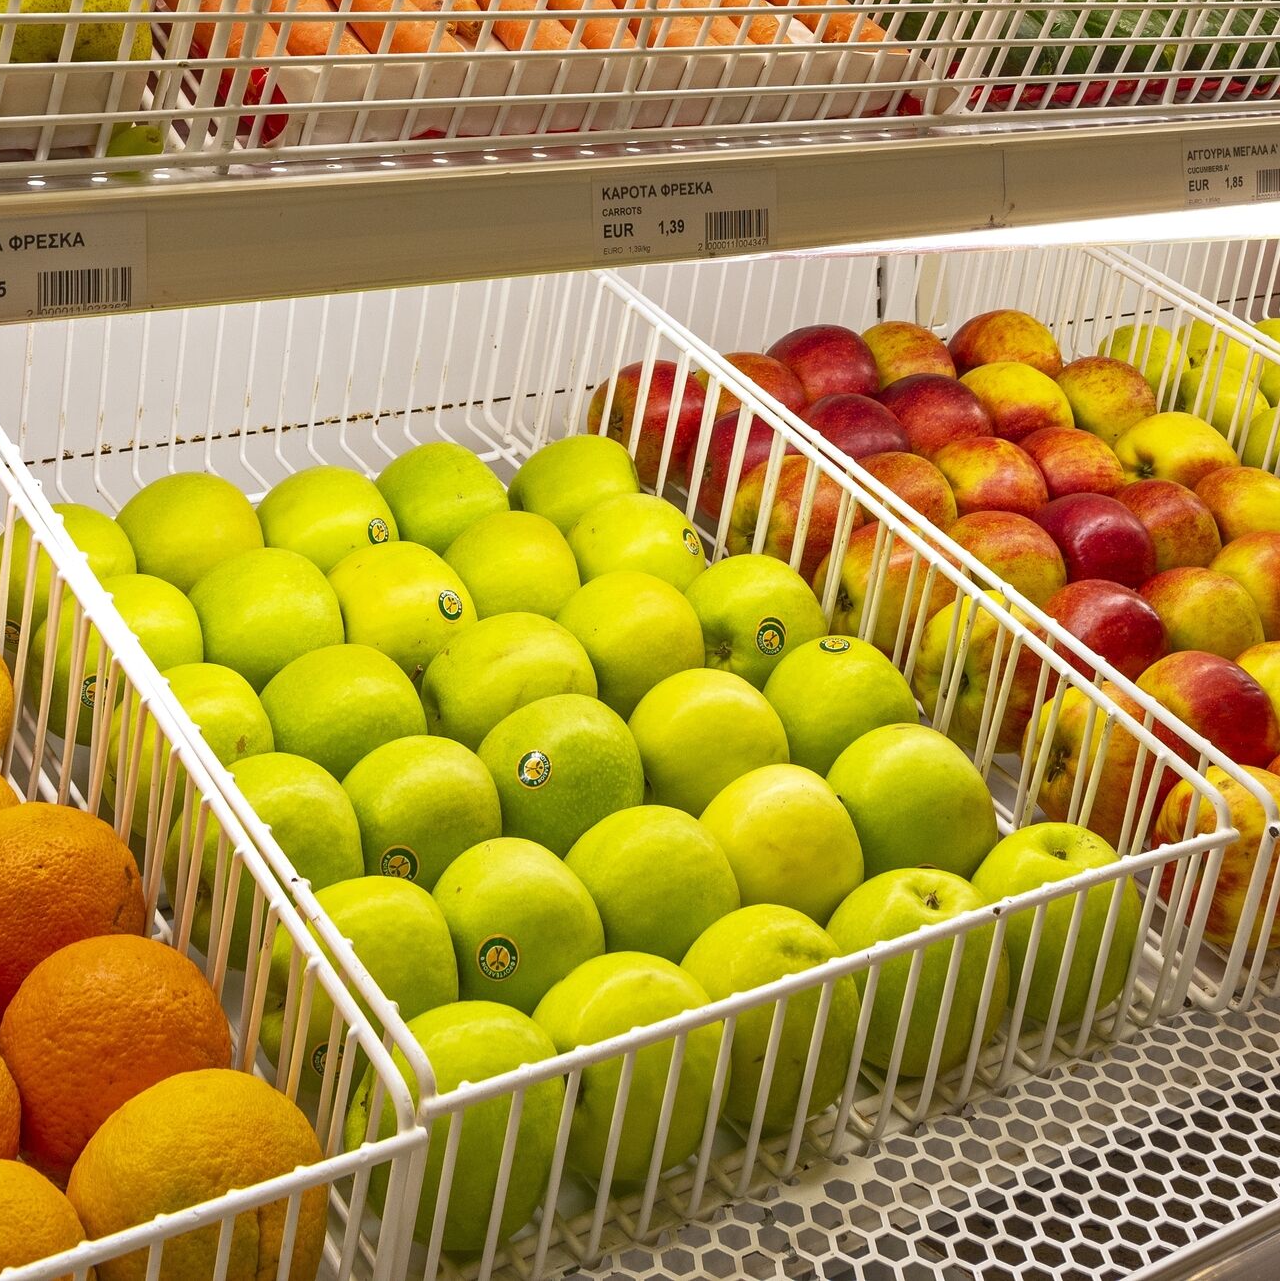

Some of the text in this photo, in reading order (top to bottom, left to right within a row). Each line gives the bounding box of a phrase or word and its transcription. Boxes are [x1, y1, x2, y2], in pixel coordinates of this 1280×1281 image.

[1187, 148, 1231, 161] ΑΓΓΟΥΡΙΑ
[1233, 144, 1269, 157] ΜΕΓΑΛΑ
[1187, 165, 1223, 174] CUCUMBERS
[602, 181, 713, 200] ΚΑΡΟΤΑ ΦΡΕΣΚΑ
[1189, 176, 1243, 192] EUR 1,85
[602, 206, 642, 217] CARROTS
[603, 220, 685, 238] EUR 1,39
[9, 232, 85, 251] ΦΡΕΣΚΑ
